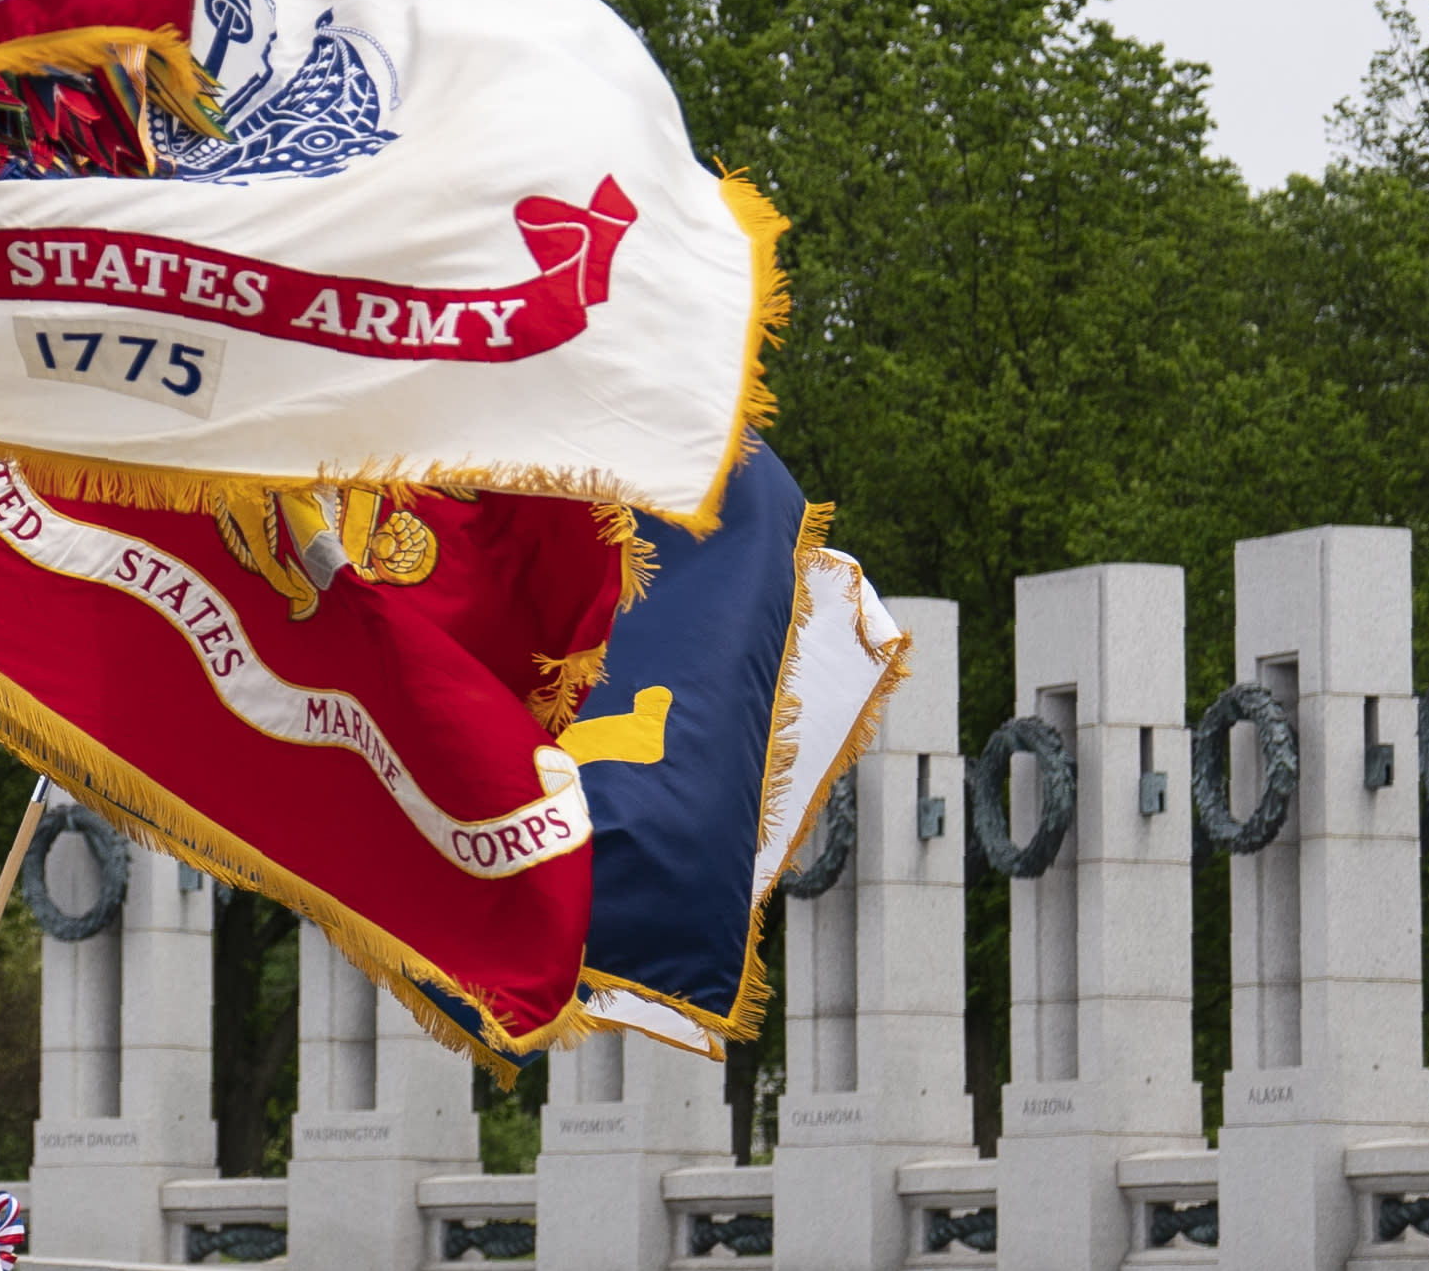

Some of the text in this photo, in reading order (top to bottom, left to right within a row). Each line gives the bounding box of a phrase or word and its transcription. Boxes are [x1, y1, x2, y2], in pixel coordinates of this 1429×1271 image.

[7, 239, 270, 317] STATES
[290, 288, 527, 347] ARMY
[36, 331, 206, 398] 1775
[115, 548, 245, 678] STATES
[304, 696, 401, 791] MARINE
[451, 807, 572, 867] CORPS
[1248, 1085, 1294, 1105] ALASKA
[1021, 1097, 1075, 1116] ARIZONA
[558, 1118, 625, 1135] WYOMING
[791, 1108, 862, 1127] OKLAHOMA
[40, 1132, 138, 1148] SOUTH DAKOTA
[301, 1126, 389, 1142] WASHINGTON
